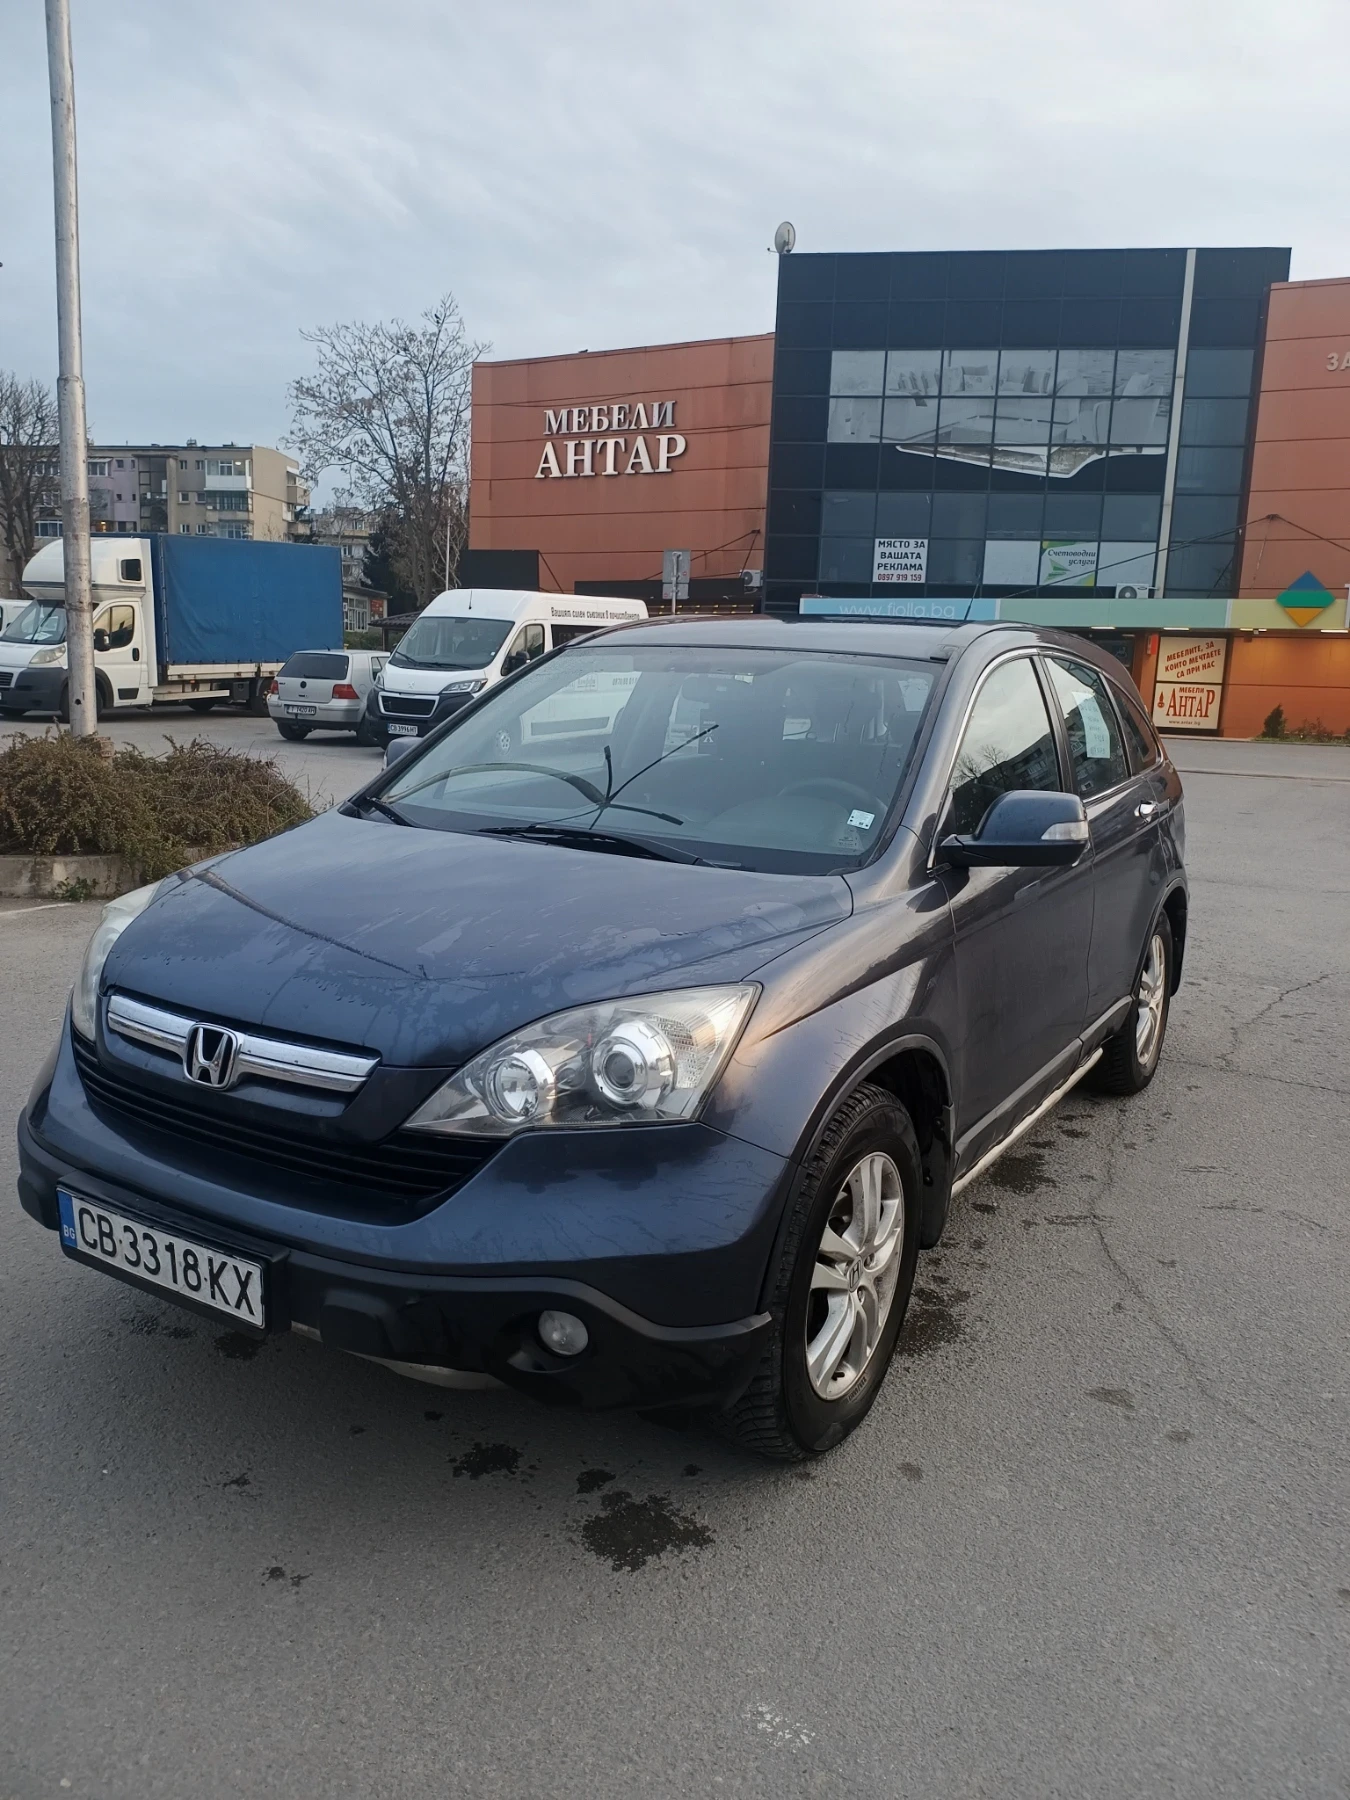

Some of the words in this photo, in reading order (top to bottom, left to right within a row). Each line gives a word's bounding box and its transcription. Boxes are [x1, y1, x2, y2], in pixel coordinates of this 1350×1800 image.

[543, 400, 677, 435] МЕБЕЛИ
[535, 434, 687, 479] АНТАР
[878, 540, 910, 549] МЯСТО
[913, 540, 926, 549] ЗА
[880, 551, 922, 560] ВАШАТА
[1047, 548, 1096, 558] Счетоводни
[877, 562, 923, 571] РЕКЛАМА
[877, 573, 894, 581] 0897
[1166, 644, 1204, 662] МЕБЕЛИТЕ,
[1205, 640, 1215, 650] ЗА
[1164, 659, 1187, 673] КОИТО
[1188, 648, 1222, 665] МЕЧТАЕТЕ
[1176, 670, 1185, 679] СА
[1186, 665, 1201, 676] ПРИ
[1202, 660, 1215, 671] НАС
[1179, 686, 1205, 694] МЕБЕЛИ
[63, 1224, 76, 1240] BG
